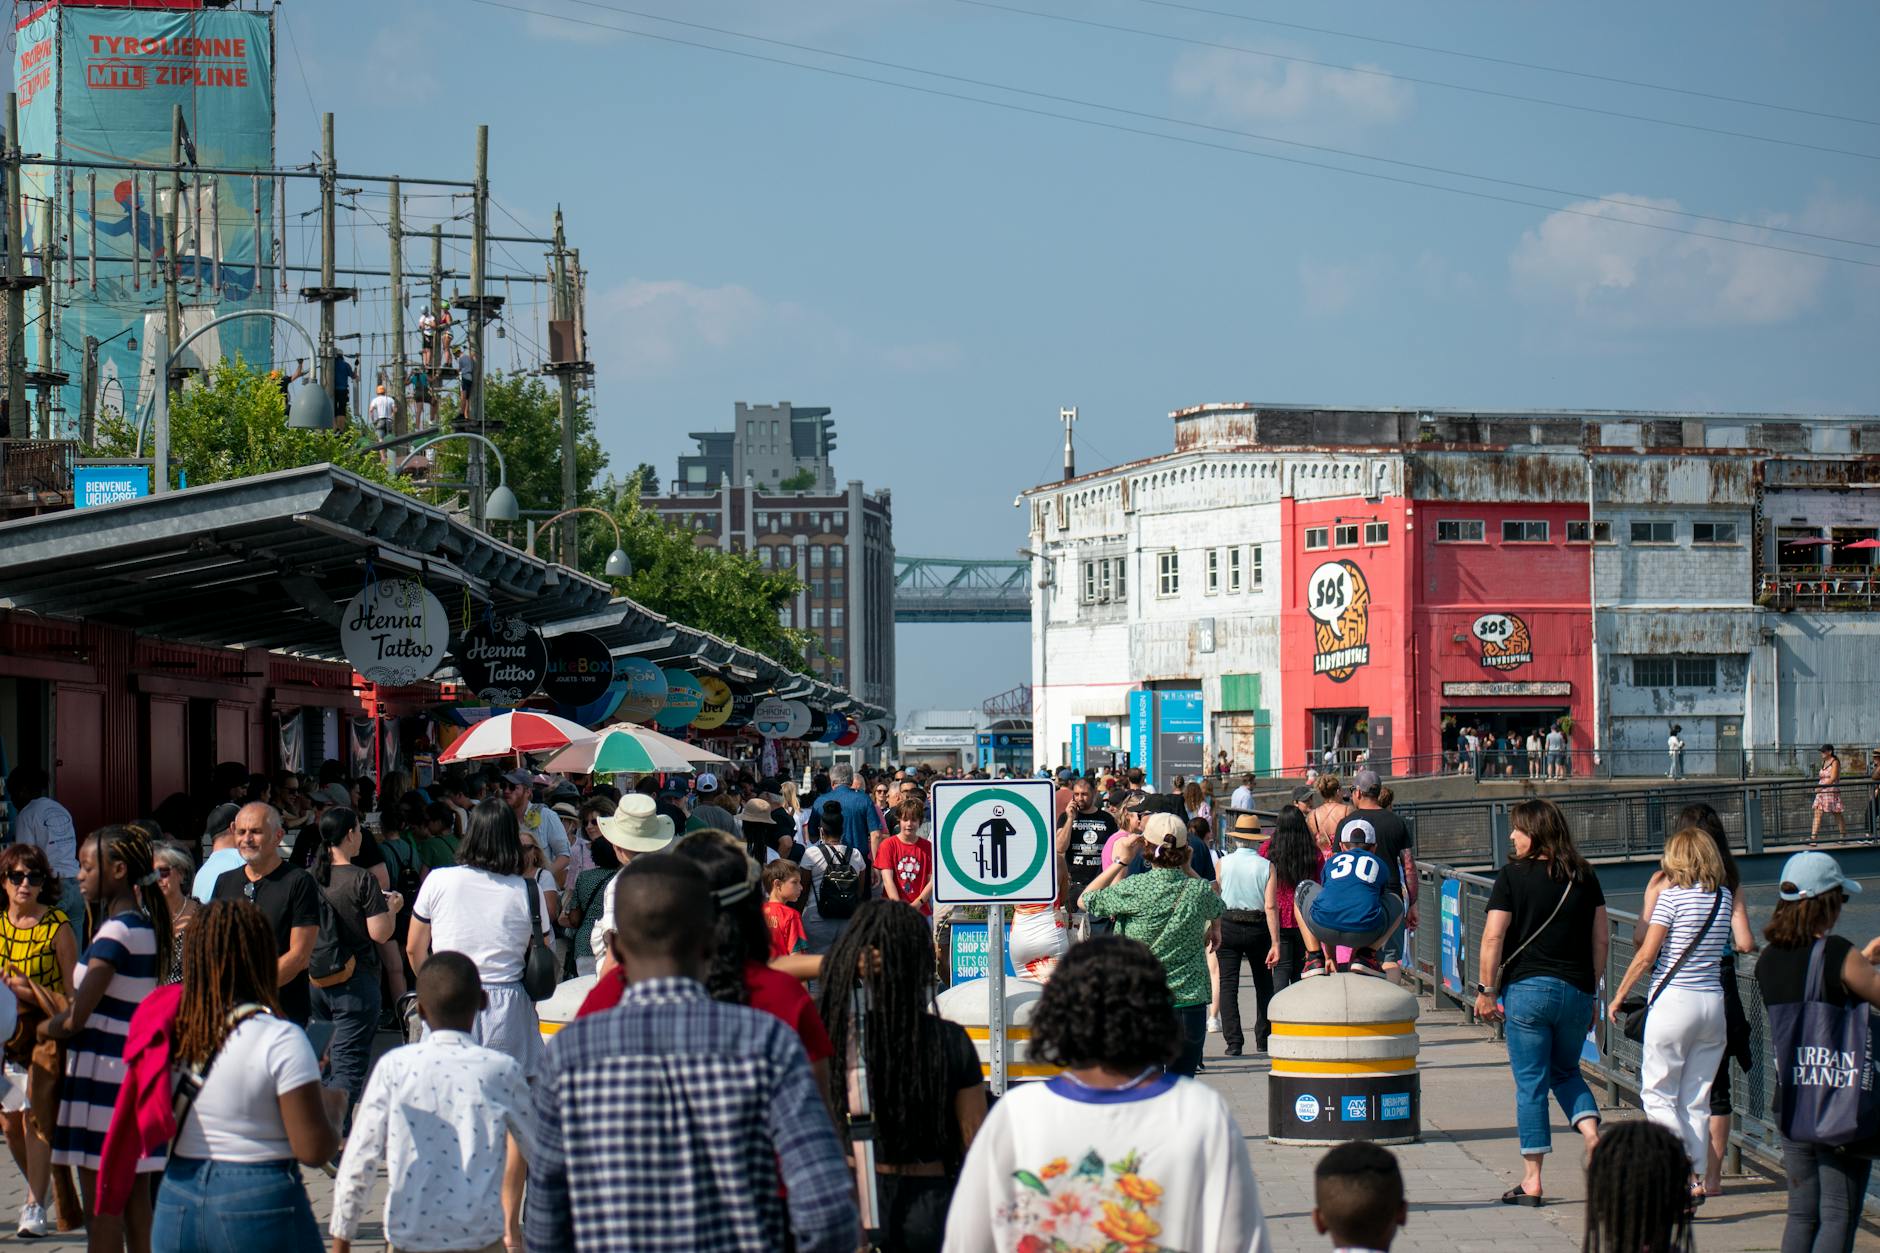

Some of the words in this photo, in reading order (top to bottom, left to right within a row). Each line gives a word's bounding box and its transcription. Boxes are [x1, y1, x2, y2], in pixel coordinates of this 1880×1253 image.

[88, 35, 246, 58] TYROLIENNE
[90, 66, 141, 87] MTL
[155, 66, 248, 88] ZIPLINE
[86, 481, 131, 492] BIENVENUE
[1316, 572, 1345, 609] SOS
[350, 604, 423, 631] Henna
[1480, 619, 1506, 635] SOS
[371, 634, 433, 660] Tattoo
[466, 637, 526, 660] Henna
[1200, 629, 1212, 650] 16
[548, 657, 611, 673] ukeBox
[1314, 647, 1368, 672] LABYRINTHE
[484, 661, 536, 684] Tattoo
[756, 708, 791, 716] CHRONO
[1139, 695, 1147, 717] BASIN
[1139, 719, 1147, 733] THE
[1139, 735, 1147, 768] ECOURS
[1330, 854, 1380, 884] 30
[957, 931, 988, 942] ACHETEZ
[957, 942, 979, 953] SHOP
[957, 955, 976, 967] LET'S
[977, 955, 988, 967] GO
[957, 966, 979, 978] SHOP
[1796, 1046, 1855, 1070] URBAN
[1792, 1067, 1859, 1089] PLANET
